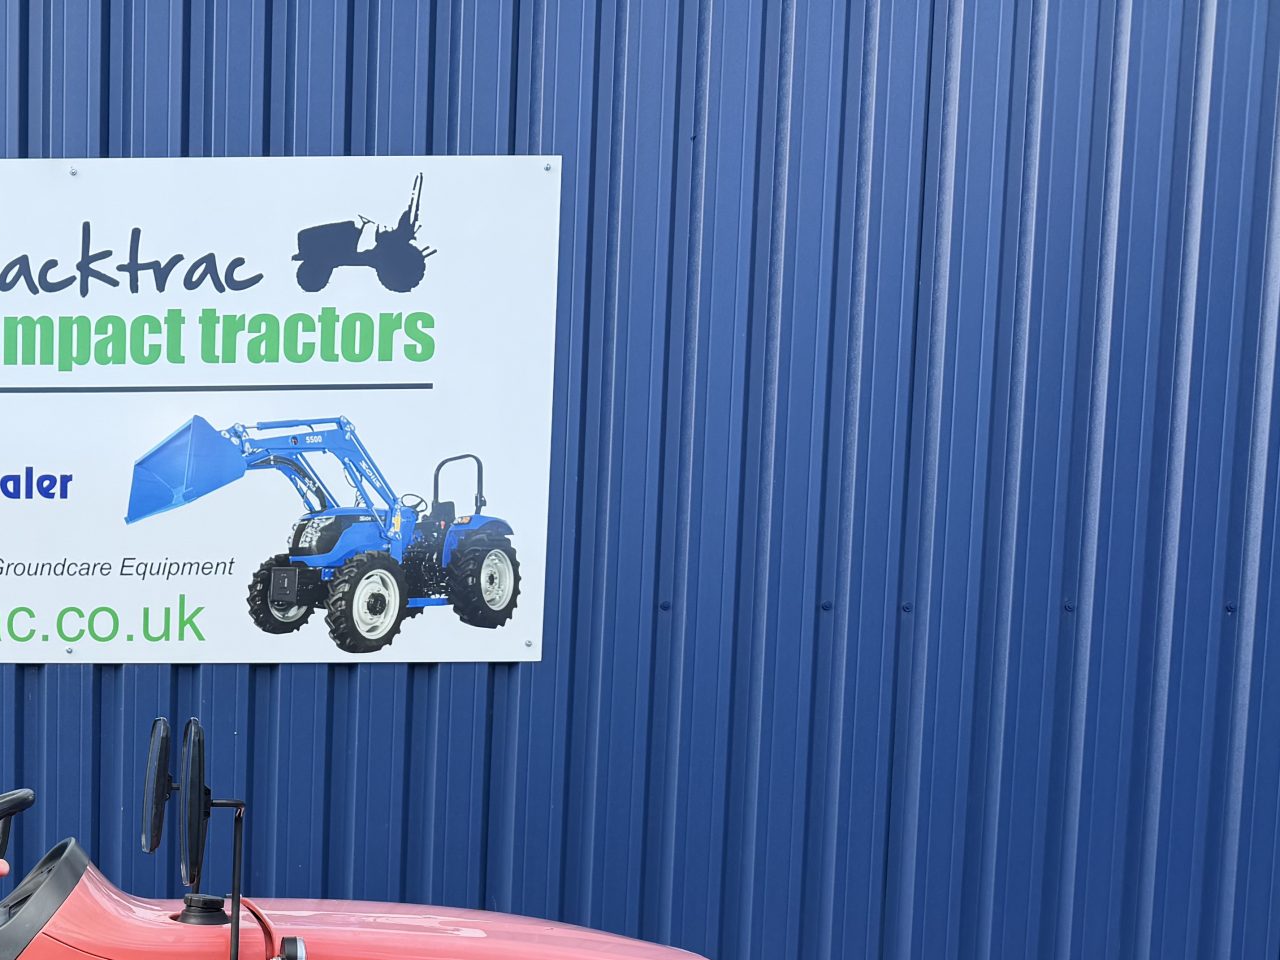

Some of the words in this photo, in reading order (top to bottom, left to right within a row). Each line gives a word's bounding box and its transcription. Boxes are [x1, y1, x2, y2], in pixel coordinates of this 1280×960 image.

[200, 308, 435, 364] tractors
[305, 435, 322, 444] 5500
[119, 557, 236, 582] Equipment
